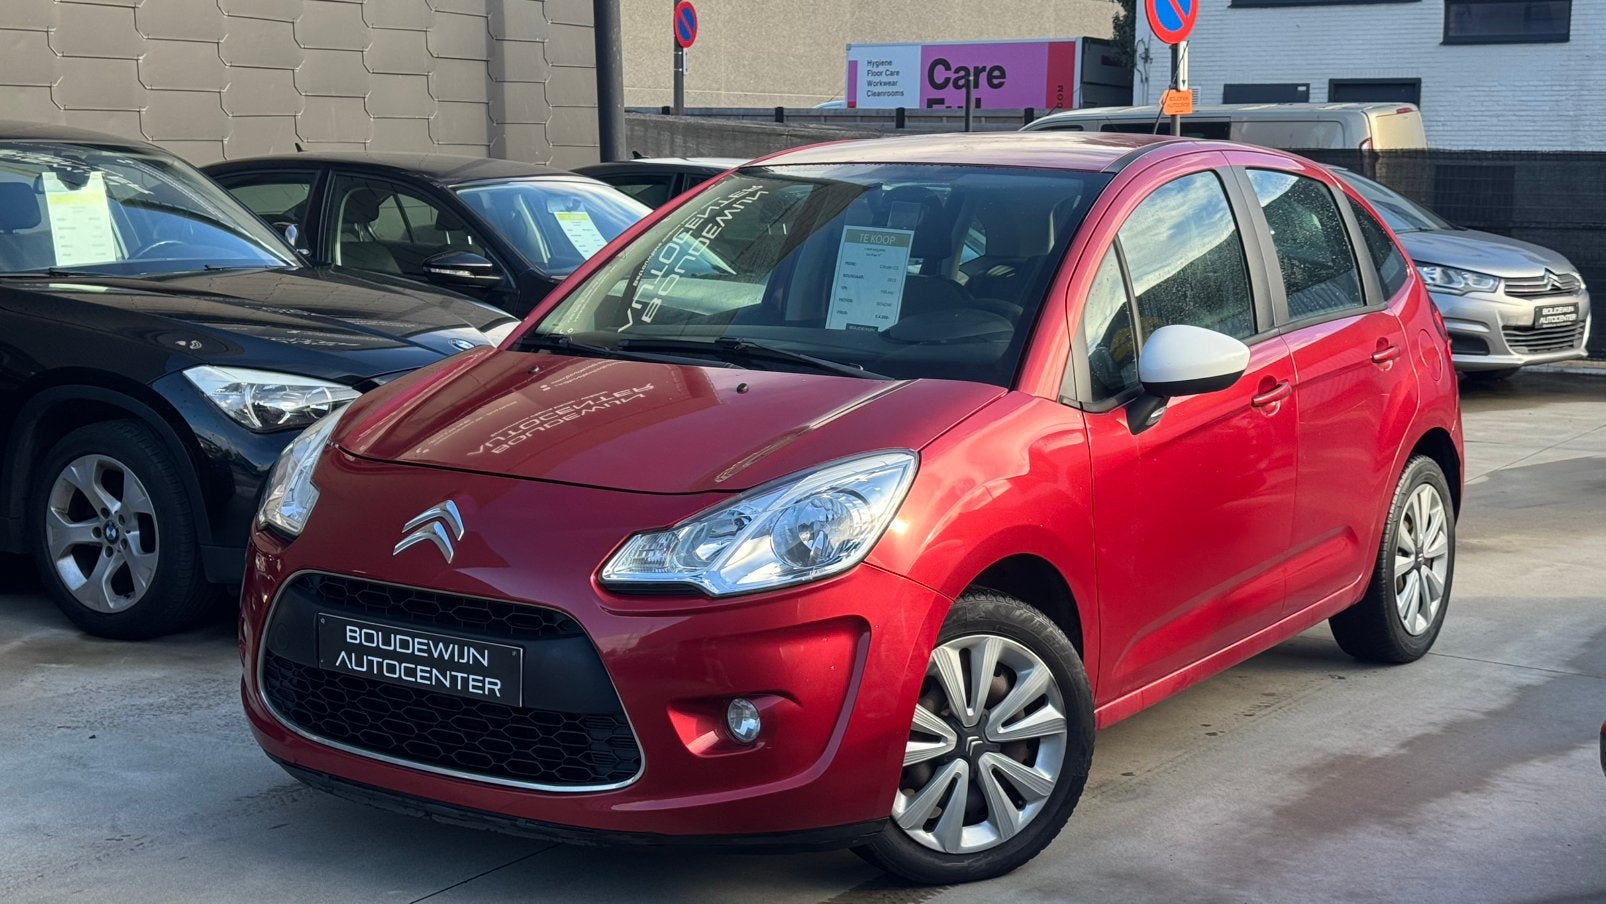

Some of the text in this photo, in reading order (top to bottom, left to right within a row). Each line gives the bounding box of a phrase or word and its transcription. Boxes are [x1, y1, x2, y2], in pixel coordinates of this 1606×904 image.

[866, 59, 893, 68] Hygiene
[866, 69, 900, 77] Floor Care
[927, 57, 1007, 90] Care
[860, 233, 897, 246] TE KOOP
[346, 625, 488, 667] BOUDEWIJN
[335, 650, 501, 697] AUTOCENTER
